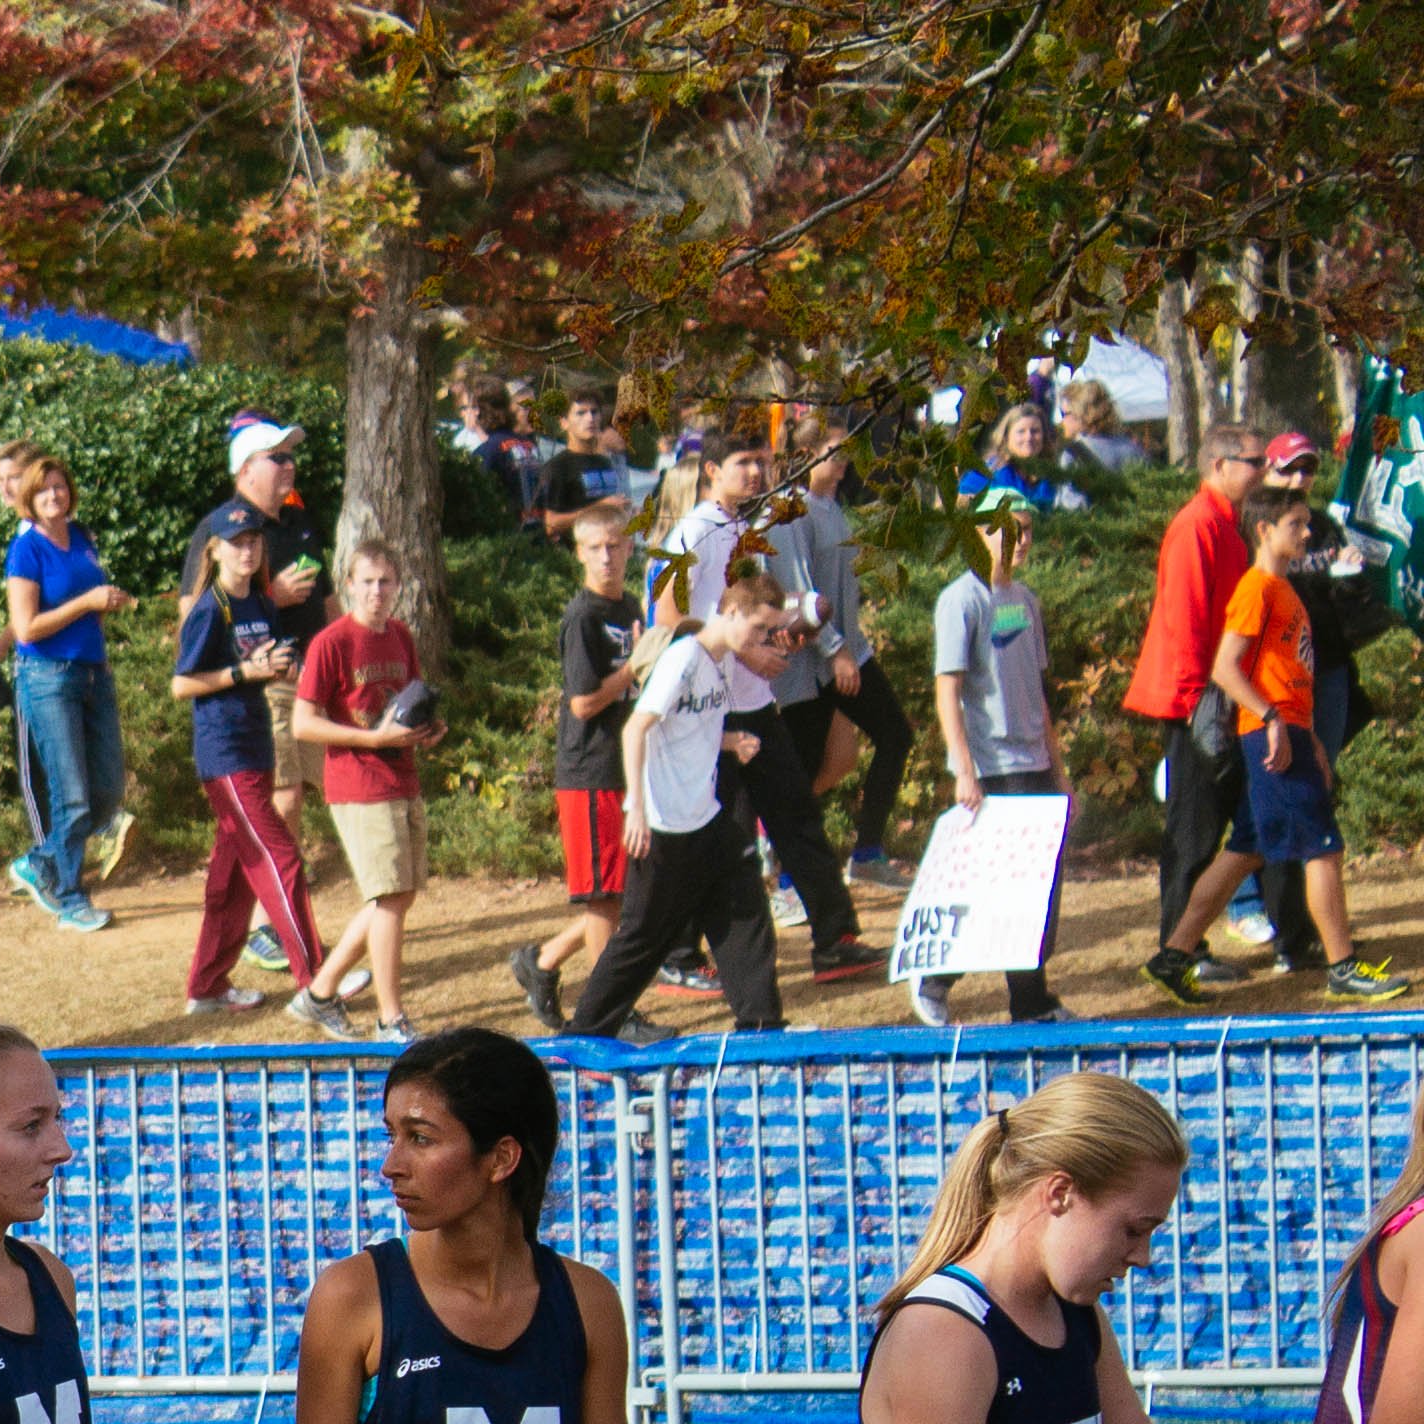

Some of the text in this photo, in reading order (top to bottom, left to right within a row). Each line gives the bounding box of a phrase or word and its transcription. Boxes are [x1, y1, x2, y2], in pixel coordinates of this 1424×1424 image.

[904, 905, 970, 942] JUST
[898, 941, 951, 974] KEEP
[411, 1355, 441, 1372] asics
